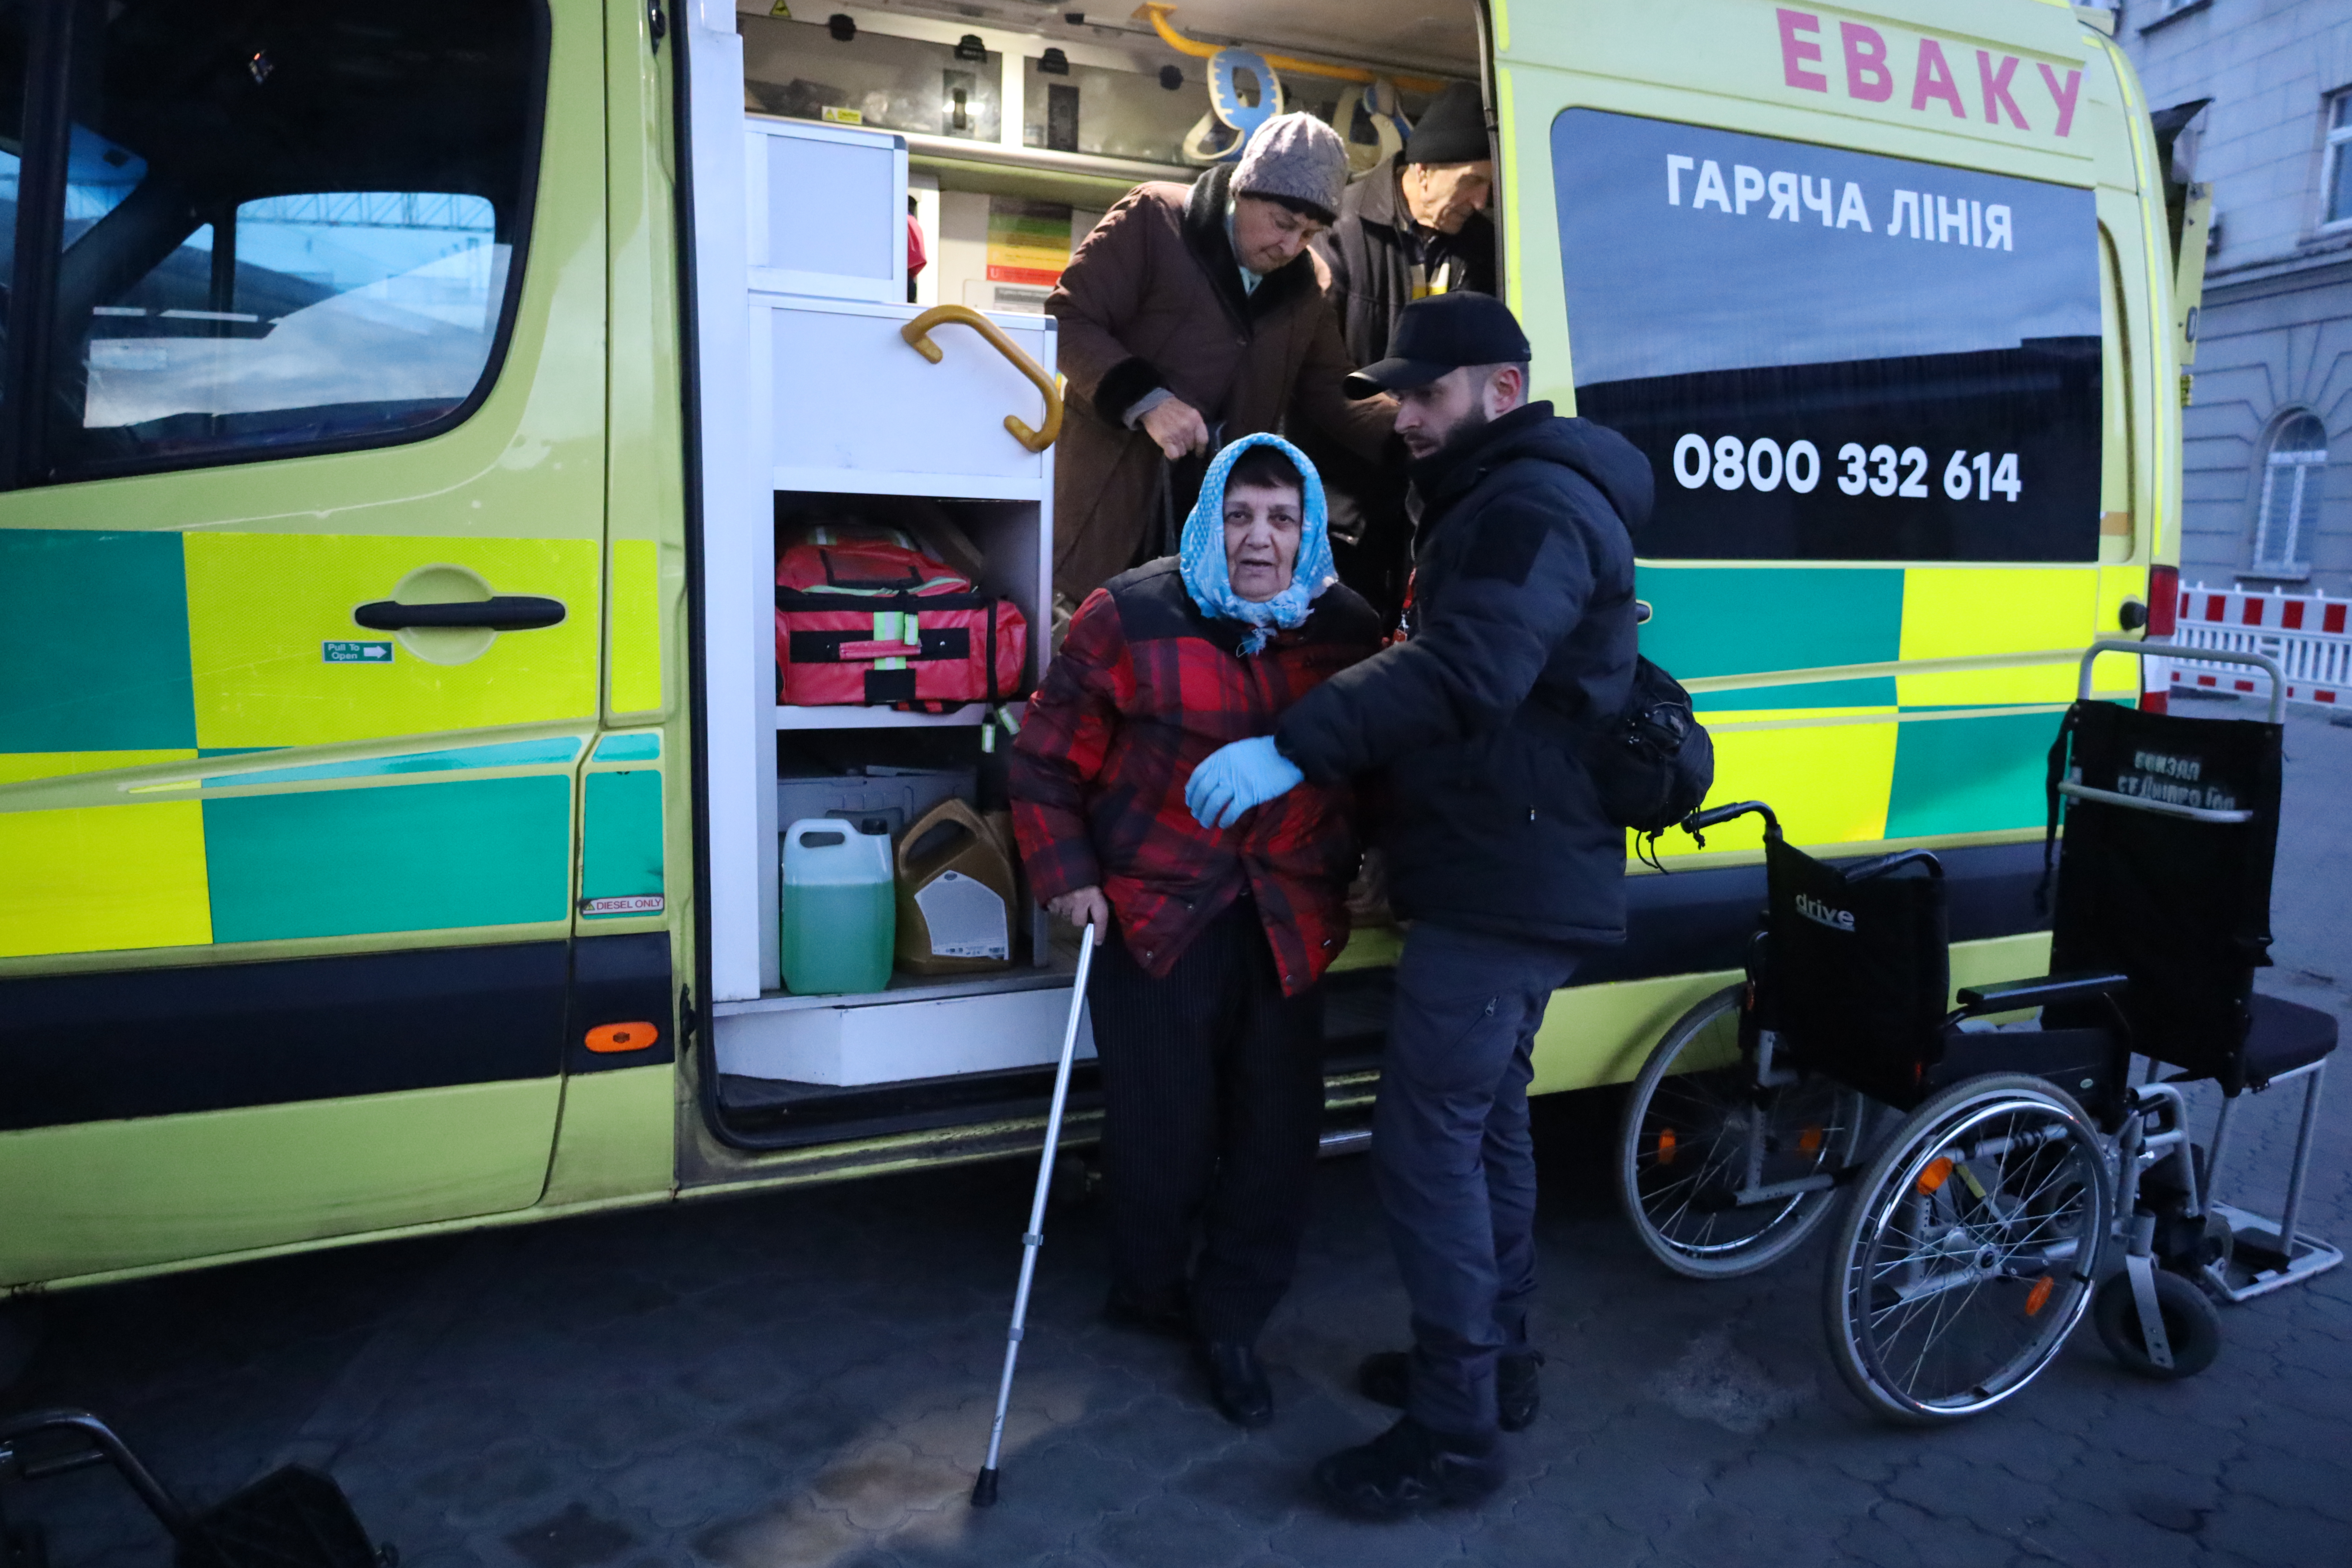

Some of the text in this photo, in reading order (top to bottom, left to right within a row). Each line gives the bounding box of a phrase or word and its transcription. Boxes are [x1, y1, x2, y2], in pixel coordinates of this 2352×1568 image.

[1776, 8, 2082, 138] ЕВАКУ
[1666, 154, 2013, 251] ГАРЯЧА ЛІНІЯ
[1673, 433, 2022, 502] 0800 332 614
[331, 652, 358, 660] Open
[596, 899, 662, 910] DIESEL ONLY
[1796, 893, 1854, 926] drive
